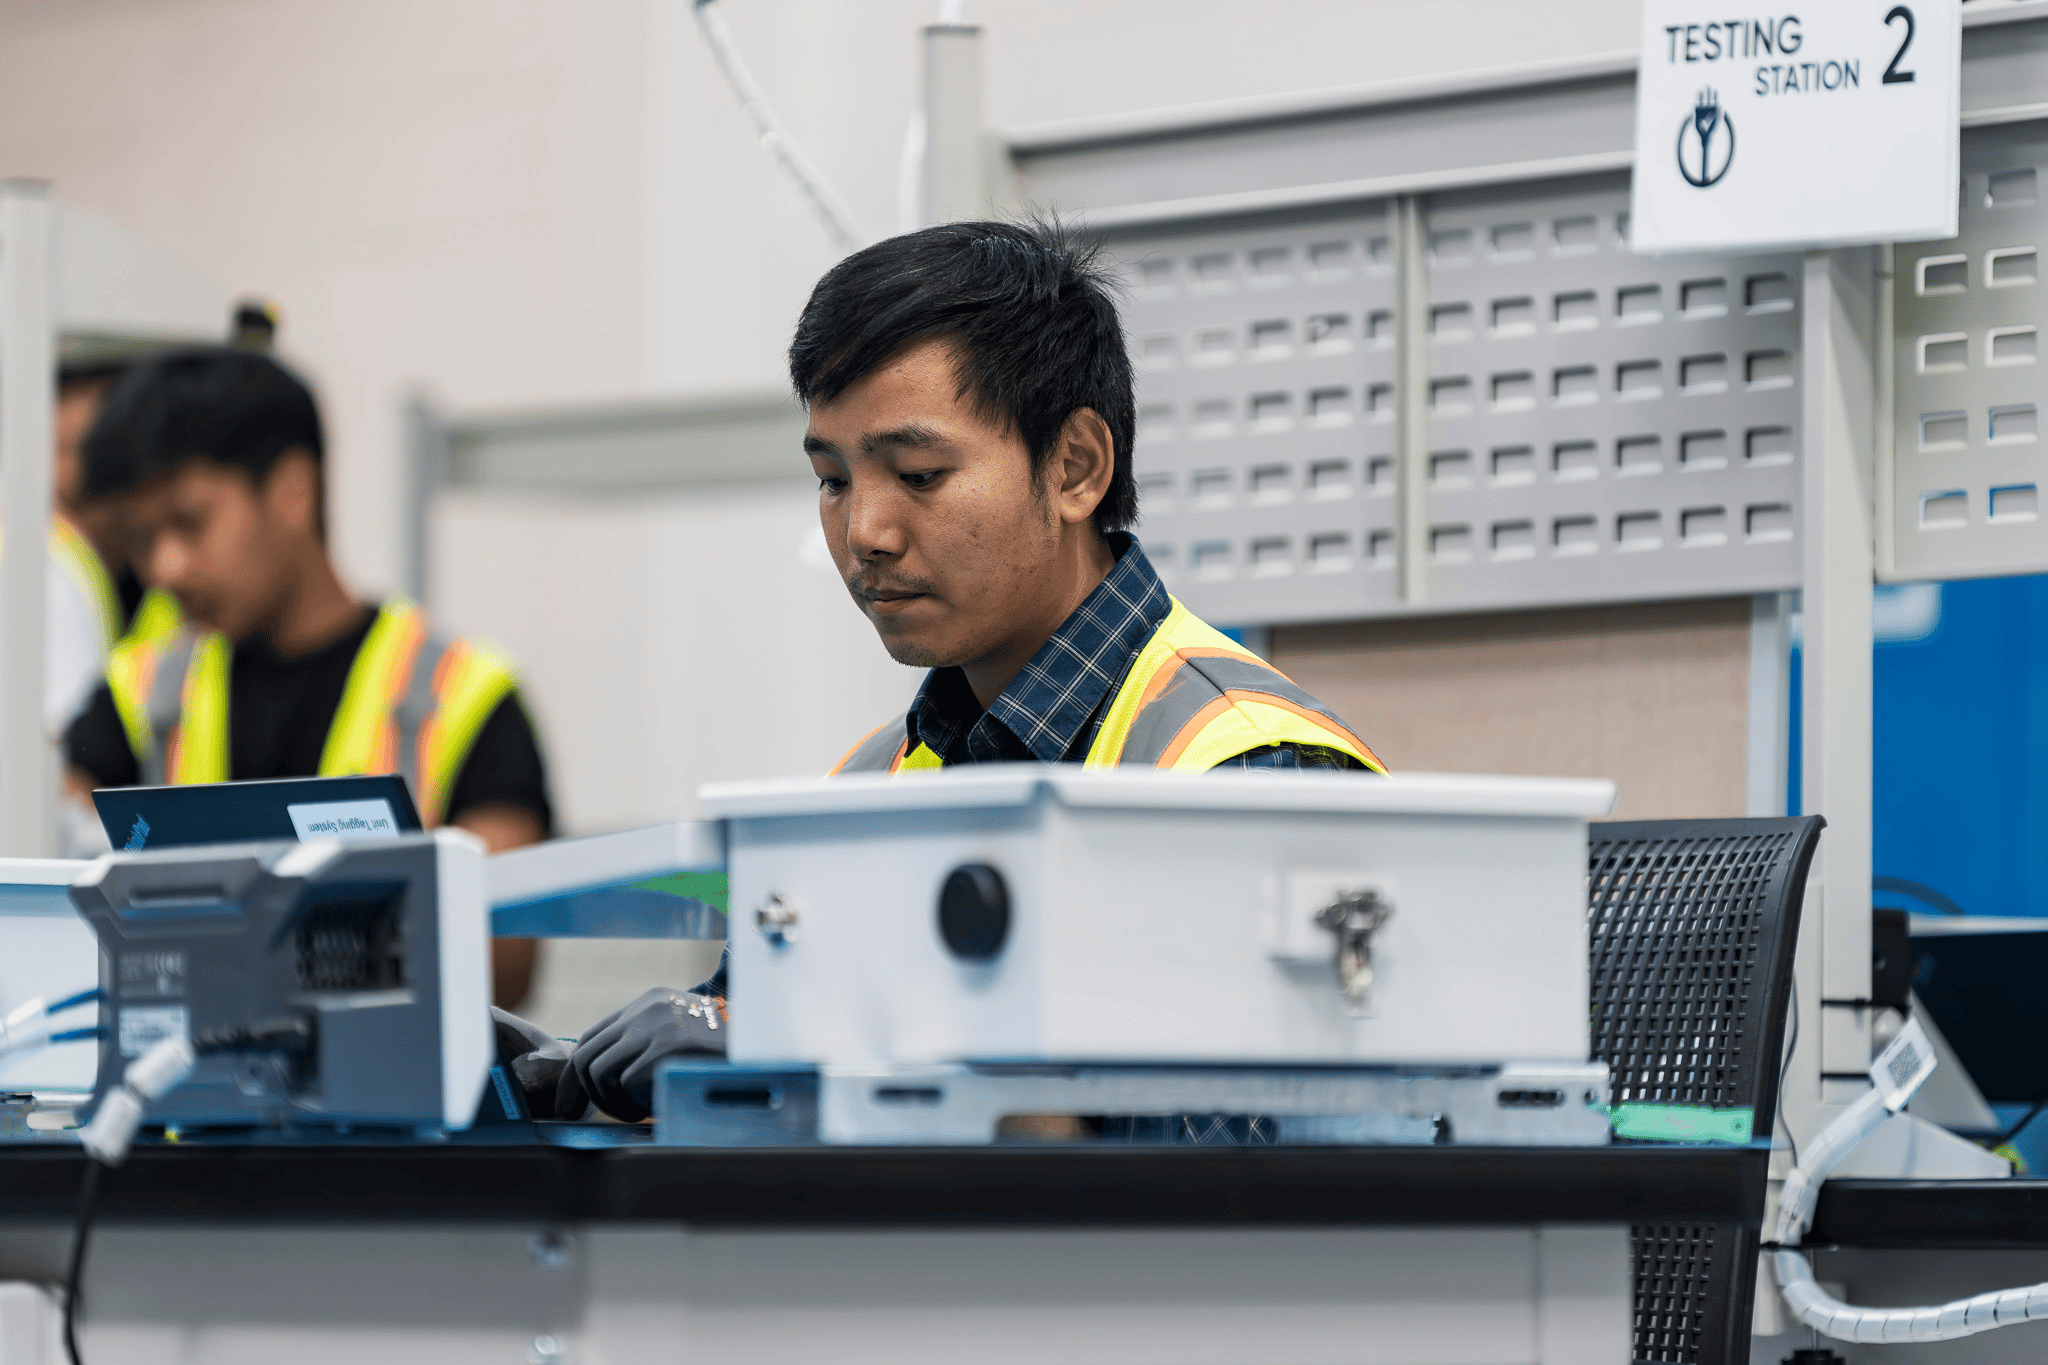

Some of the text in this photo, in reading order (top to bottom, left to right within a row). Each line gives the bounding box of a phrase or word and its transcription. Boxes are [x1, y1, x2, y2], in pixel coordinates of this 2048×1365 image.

[1665, 15, 1803, 64] TESTING
[1882, 5, 1916, 85] 2
[1755, 58, 1860, 97] STATION
[306, 817, 390, 834] Unit Tagging System
